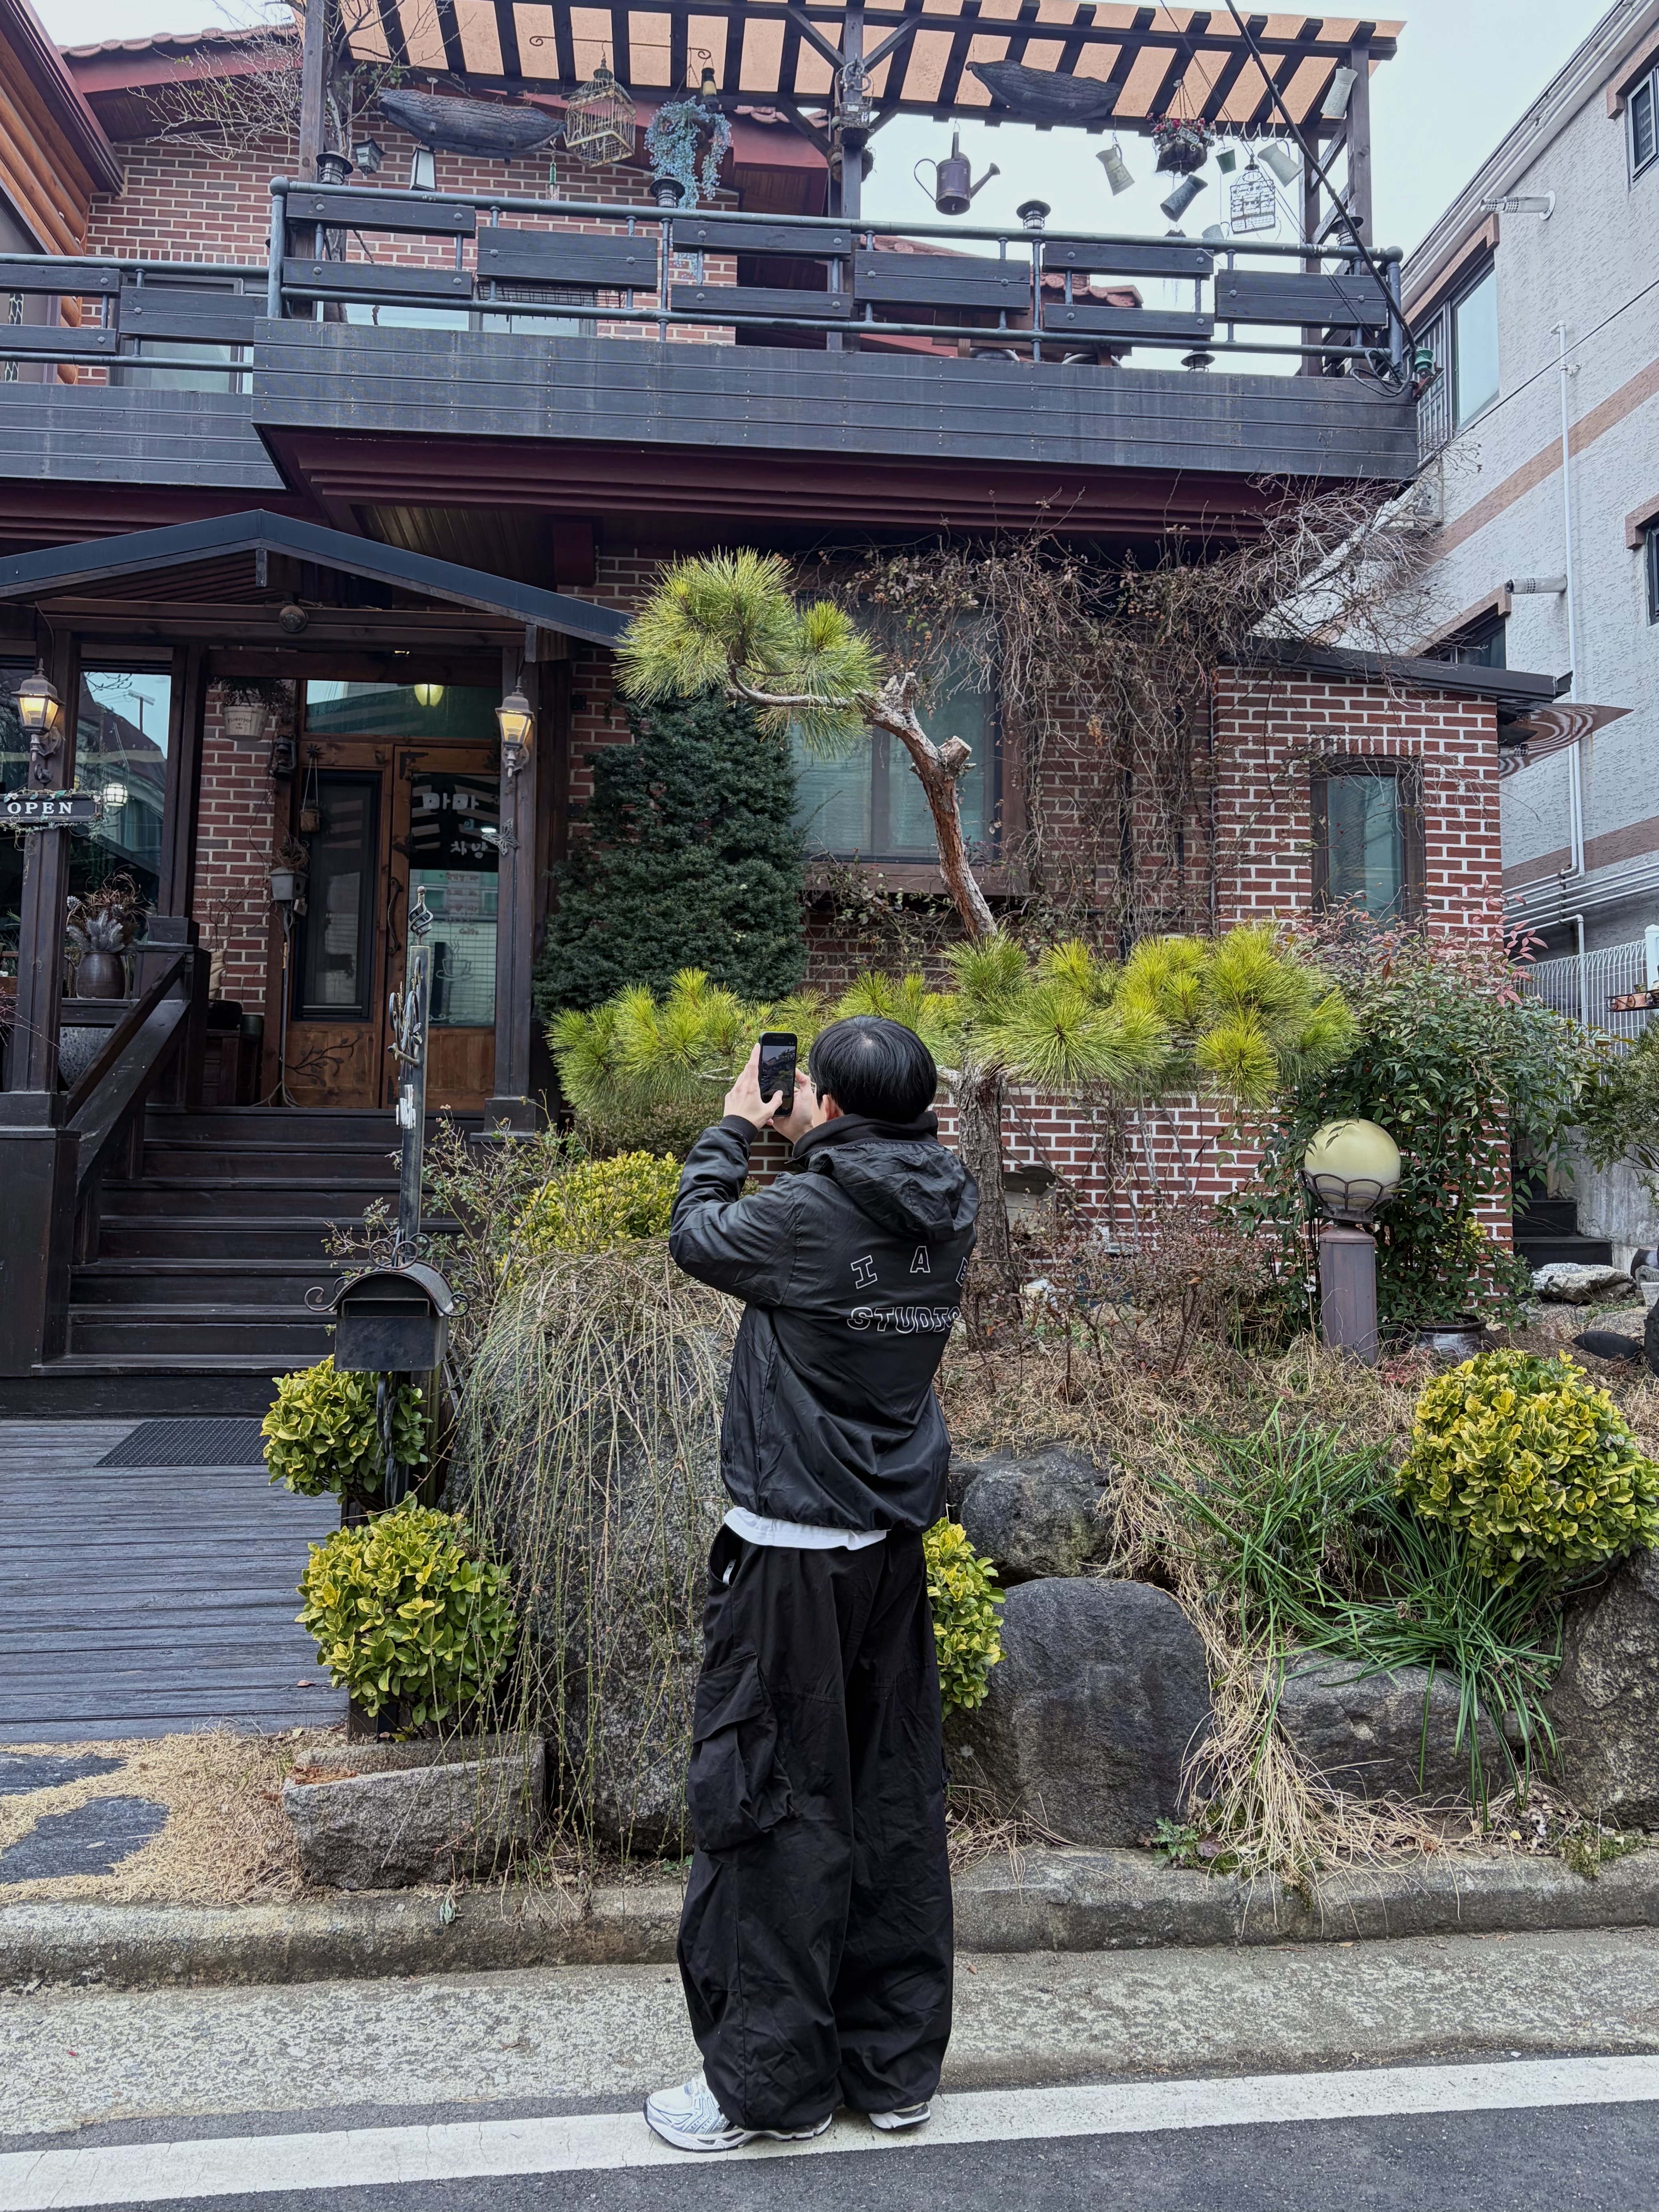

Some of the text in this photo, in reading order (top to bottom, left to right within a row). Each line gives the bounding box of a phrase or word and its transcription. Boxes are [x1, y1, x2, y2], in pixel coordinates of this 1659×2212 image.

[7, 802, 73, 814] OPEN
[422, 792, 479, 810] 마마
[463, 818, 474, 831] 의
[910, 1246, 930, 1273] A
